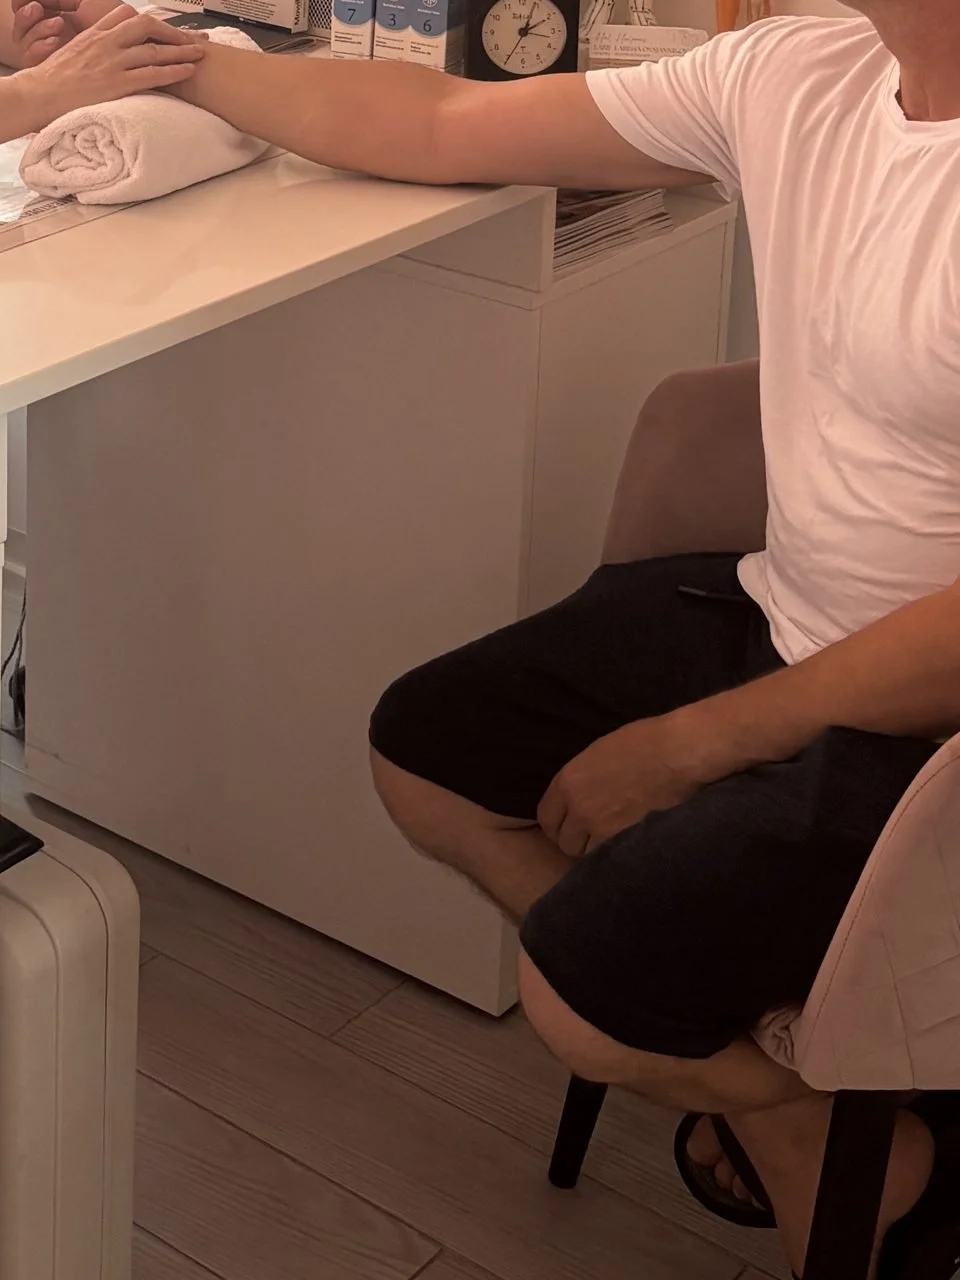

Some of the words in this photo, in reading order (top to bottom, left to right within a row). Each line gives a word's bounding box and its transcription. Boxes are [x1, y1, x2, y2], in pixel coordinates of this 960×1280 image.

[347, 8, 356, 22] 7
[388, 13, 396, 27] 3
[423, 19, 432, 33] 6
